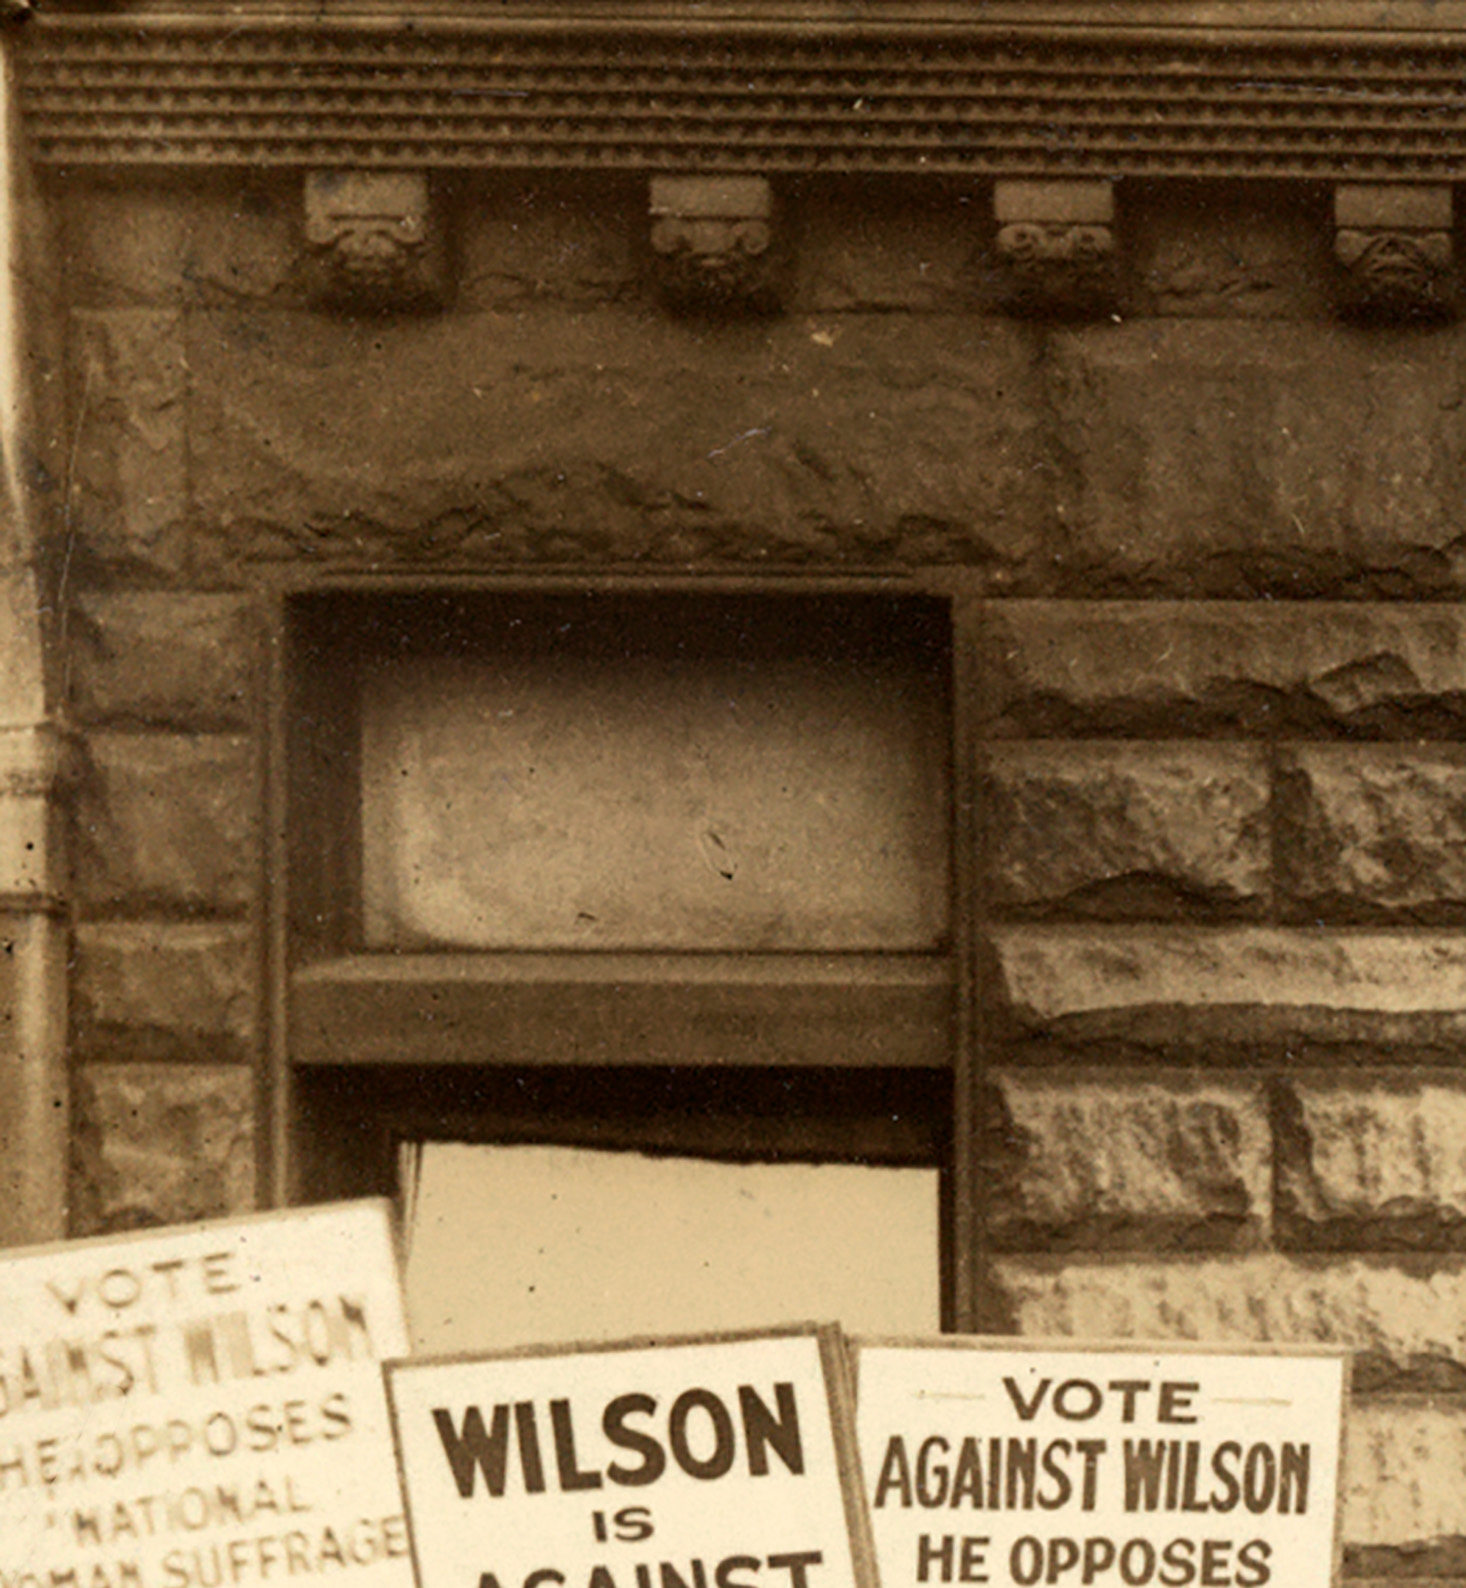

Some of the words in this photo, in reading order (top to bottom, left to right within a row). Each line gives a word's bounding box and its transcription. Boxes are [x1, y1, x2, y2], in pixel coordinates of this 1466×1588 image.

[46, 1251, 240, 1316] VOTE
[1002, 1375, 1201, 1424] VOTE
[94, 1393, 354, 1481] OPPOSES
[432, 1381, 804, 1498] WILSON
[874, 1434, 1107, 1511] AGAINST
[1123, 1439, 1311, 1516] WILSON
[71, 1475, 313, 1548] NATIONAL
[593, 1506, 655, 1543] IS
[916, 1535, 990, 1585] HE
[1010, 1537, 1272, 1588] OPPOSES
